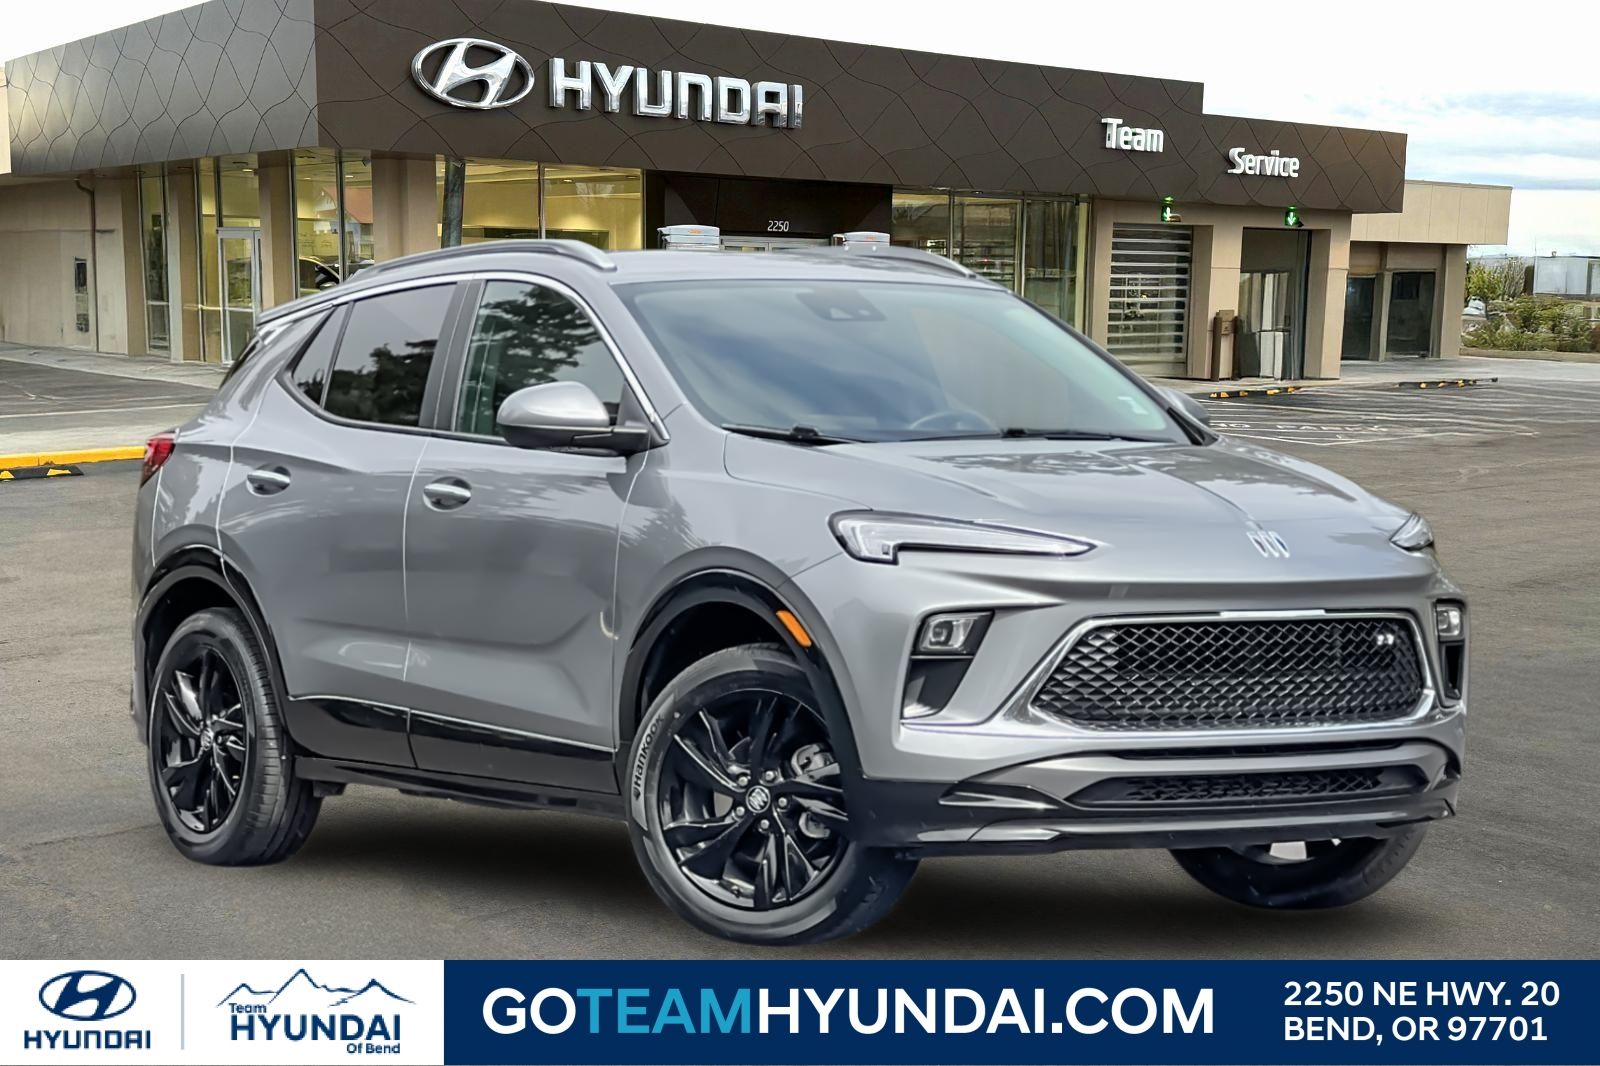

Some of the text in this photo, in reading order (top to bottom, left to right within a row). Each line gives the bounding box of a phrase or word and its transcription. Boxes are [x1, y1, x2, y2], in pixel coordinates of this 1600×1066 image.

[549, 57, 803, 129] HYUNDAI
[1101, 117, 1164, 152] Team
[1227, 147, 1300, 177] Service
[767, 220, 790, 232] 2250
